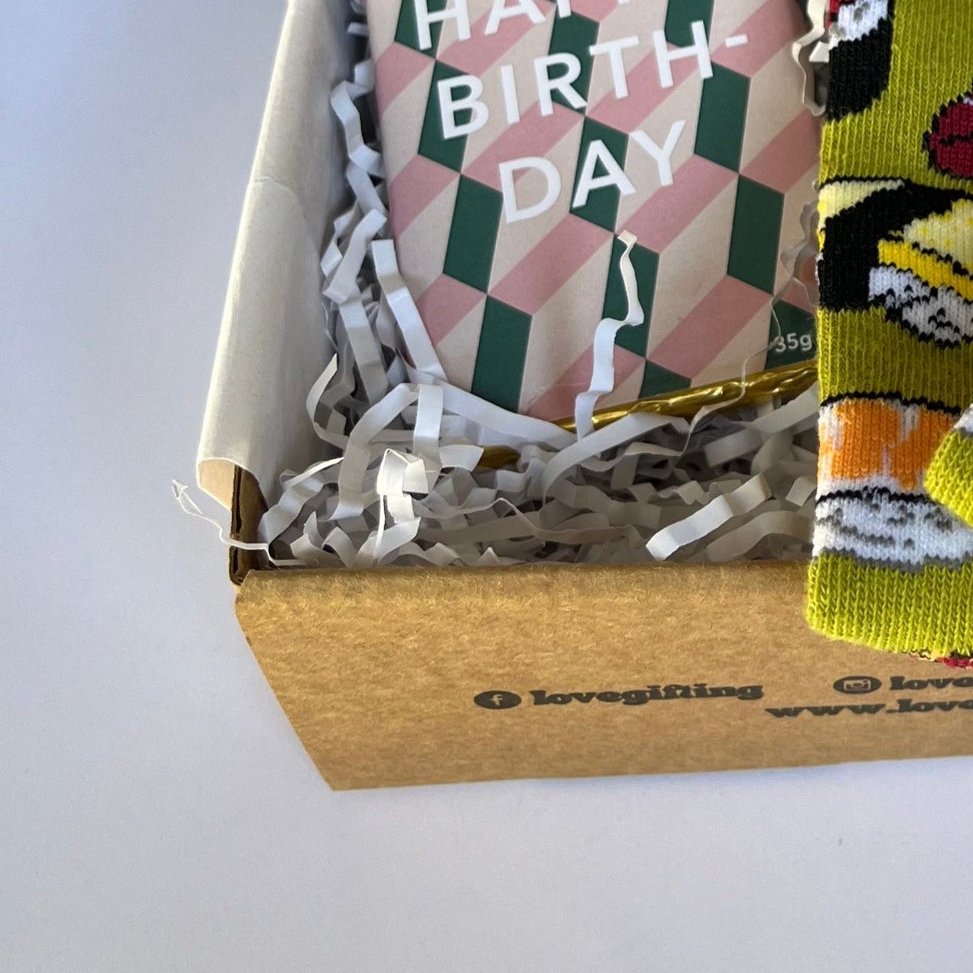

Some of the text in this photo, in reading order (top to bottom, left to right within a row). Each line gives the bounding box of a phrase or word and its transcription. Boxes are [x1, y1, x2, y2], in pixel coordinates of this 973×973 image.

[437, 20, 749, 140] BIRTH-
[499, 119, 686, 224] DAY
[775, 332, 813, 353] 35g
[529, 683, 764, 705] lovegifting
